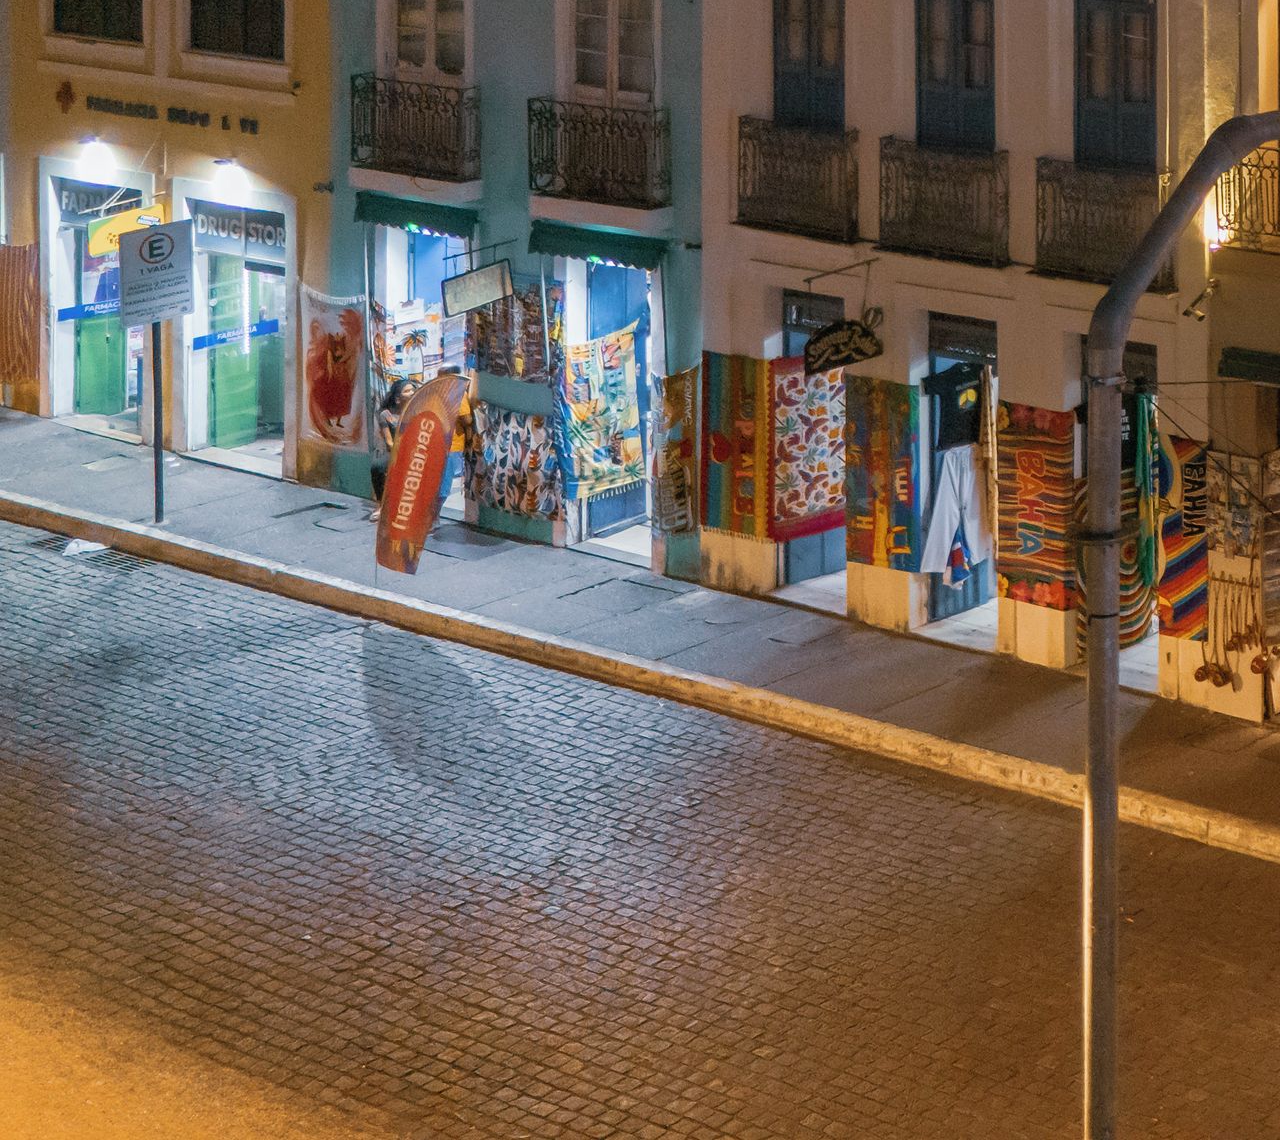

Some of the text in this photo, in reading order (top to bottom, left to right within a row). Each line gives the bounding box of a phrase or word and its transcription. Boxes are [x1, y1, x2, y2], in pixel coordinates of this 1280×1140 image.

[147, 262, 175, 274] VAGA
[148, 237, 166, 259] E
[391, 418, 435, 530] havaianas
[1016, 449, 1046, 555] BAHIA
